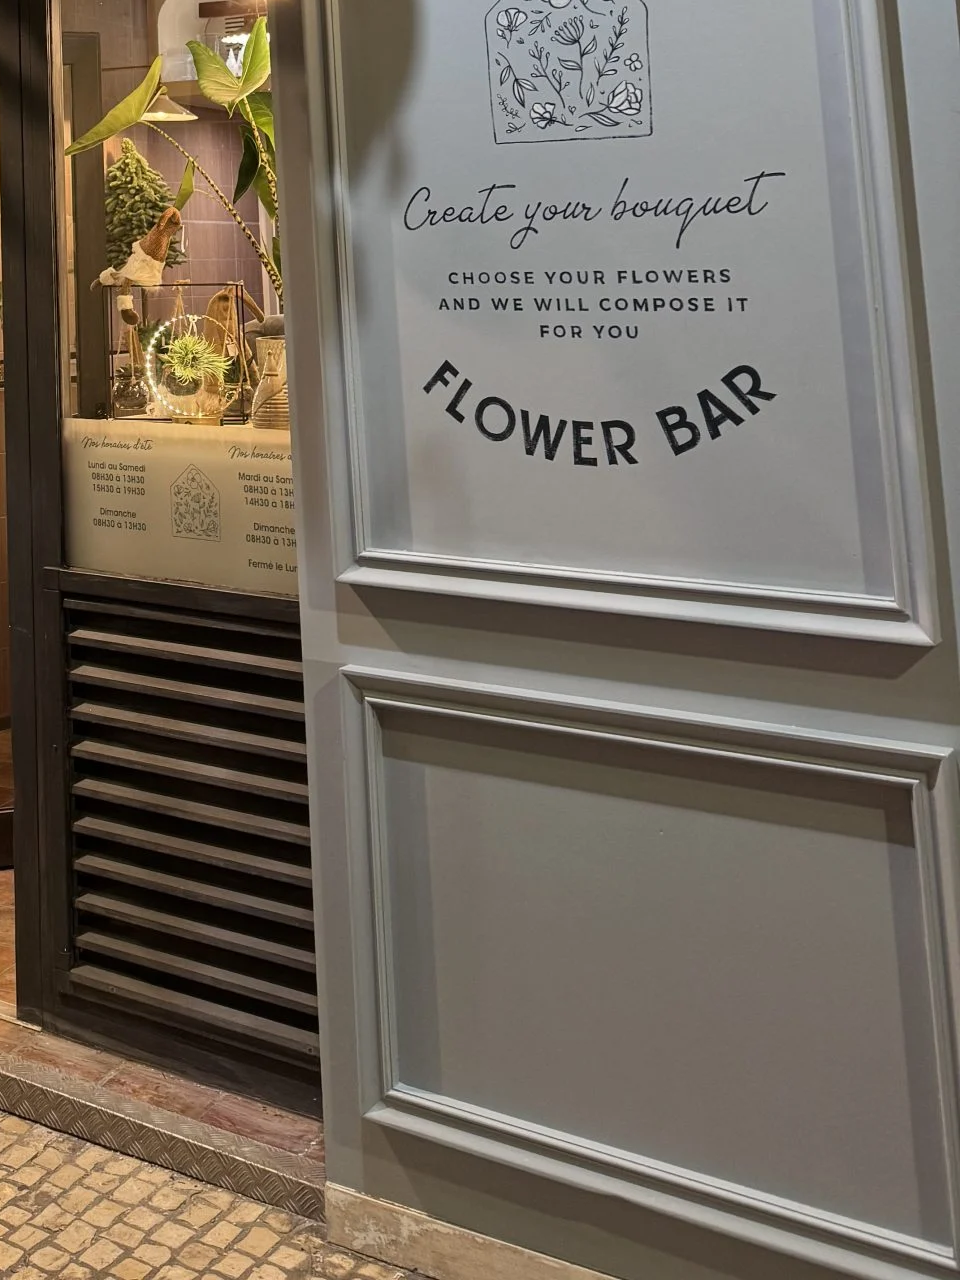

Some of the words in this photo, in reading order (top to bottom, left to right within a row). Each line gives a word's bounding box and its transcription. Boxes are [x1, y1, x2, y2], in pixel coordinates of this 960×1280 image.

[403, 183, 517, 231] Create
[509, 200, 603, 250] your
[610, 170, 787, 249] bouquet
[448, 271, 536, 286] CHOOSE
[544, 269, 607, 285] YOUR
[616, 268, 732, 284] FLOWERS
[438, 297, 481, 312] AND
[490, 297, 524, 312] WE
[533, 297, 590, 312] WILL
[599, 296, 716, 312] COMPOSE
[727, 297, 750, 312] IT
[539, 324, 583, 339] FOR
[593, 324, 639, 339] YOU
[423, 359, 639, 468] FLOWER
[655, 364, 778, 457] BAR
[100, 435, 131, 450] horaires
[250, 445, 286, 461] horaires
[87, 460, 107, 470] Lundi
[107, 463, 118, 471] au
[119, 462, 147, 473] Samedi
[91, 472, 114, 482] 08H30
[123, 474, 146, 485] 13H30
[238, 471, 261, 482] Mardi
[262, 475, 274, 483] au
[92, 483, 115, 494] 15H30
[123, 486, 146, 496] 19H30
[243, 484, 269, 495] 08H30
[245, 496, 270, 507] 14H30
[99, 507, 137, 519] Dimanche
[93, 518, 116, 528] 08H30
[124, 521, 147, 532] 13H30
[253, 522, 296, 535] Dimanche
[245, 533, 271, 545] 08H30
[248, 558, 274, 570] Fermé
[275, 561, 283, 571] le
